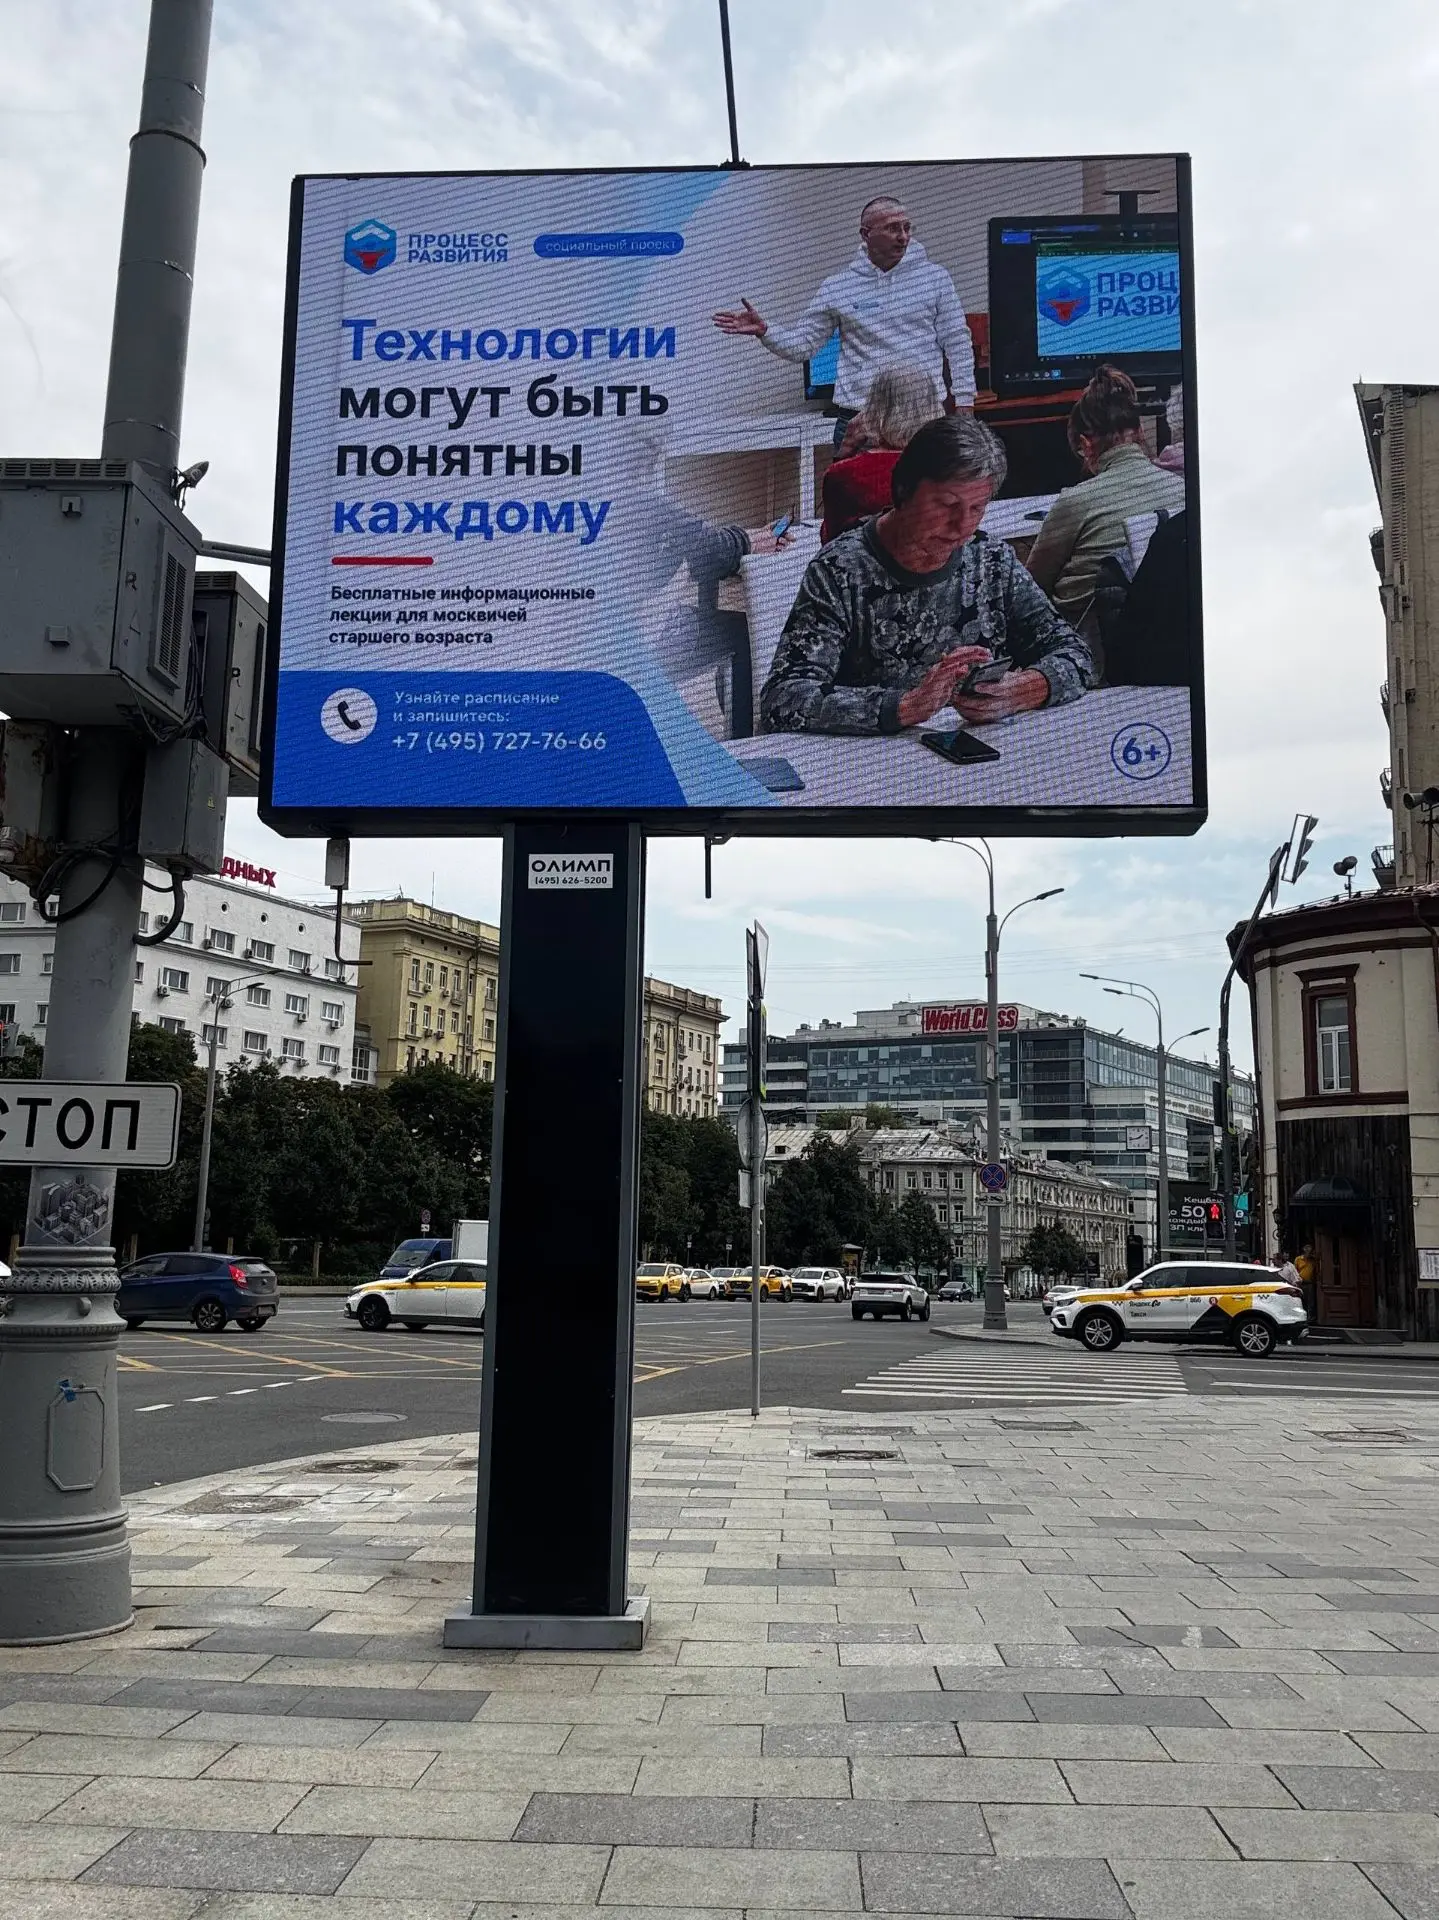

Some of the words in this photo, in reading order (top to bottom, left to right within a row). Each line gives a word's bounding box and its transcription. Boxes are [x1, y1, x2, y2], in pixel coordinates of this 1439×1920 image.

[408, 232, 509, 249] ПРОЦЕСС
[545, 239, 627, 252] социальный
[631, 240, 676, 251] проект
[407, 248, 508, 263] РАЗВИТИЯ
[342, 319, 676, 361] Технологии
[339, 386, 511, 430] могут
[527, 374, 669, 417] быть
[336, 444, 582, 477] понятны
[334, 500, 612, 545] каждому
[331, 586, 436, 601] Бесплатные
[440, 586, 596, 604] информационные
[329, 610, 391, 624] лекции
[396, 610, 428, 624] для
[433, 607, 527, 623] москвичей
[328, 632, 410, 647] старшего
[414, 632, 493, 647] возраста
[395, 691, 460, 705] Узнайте
[465, 692, 560, 708] расписание
[393, 711, 401, 722] и
[407, 711, 510, 723] запишитесь:
[392, 732, 420, 750] +7
[427, 732, 484, 753] (495)
[492, 732, 607, 751] 727-76-66
[1123, 738, 1161, 765] 6+
[531, 860, 610, 872] ОЛИМП
[535, 876, 560, 885] (495)
[562, 876, 608, 885] 626-5200
[925, 1008, 970, 1031] World
[972, 1006, 1016, 1030] Clss
[0, 1097, 141, 1151] ТОП
